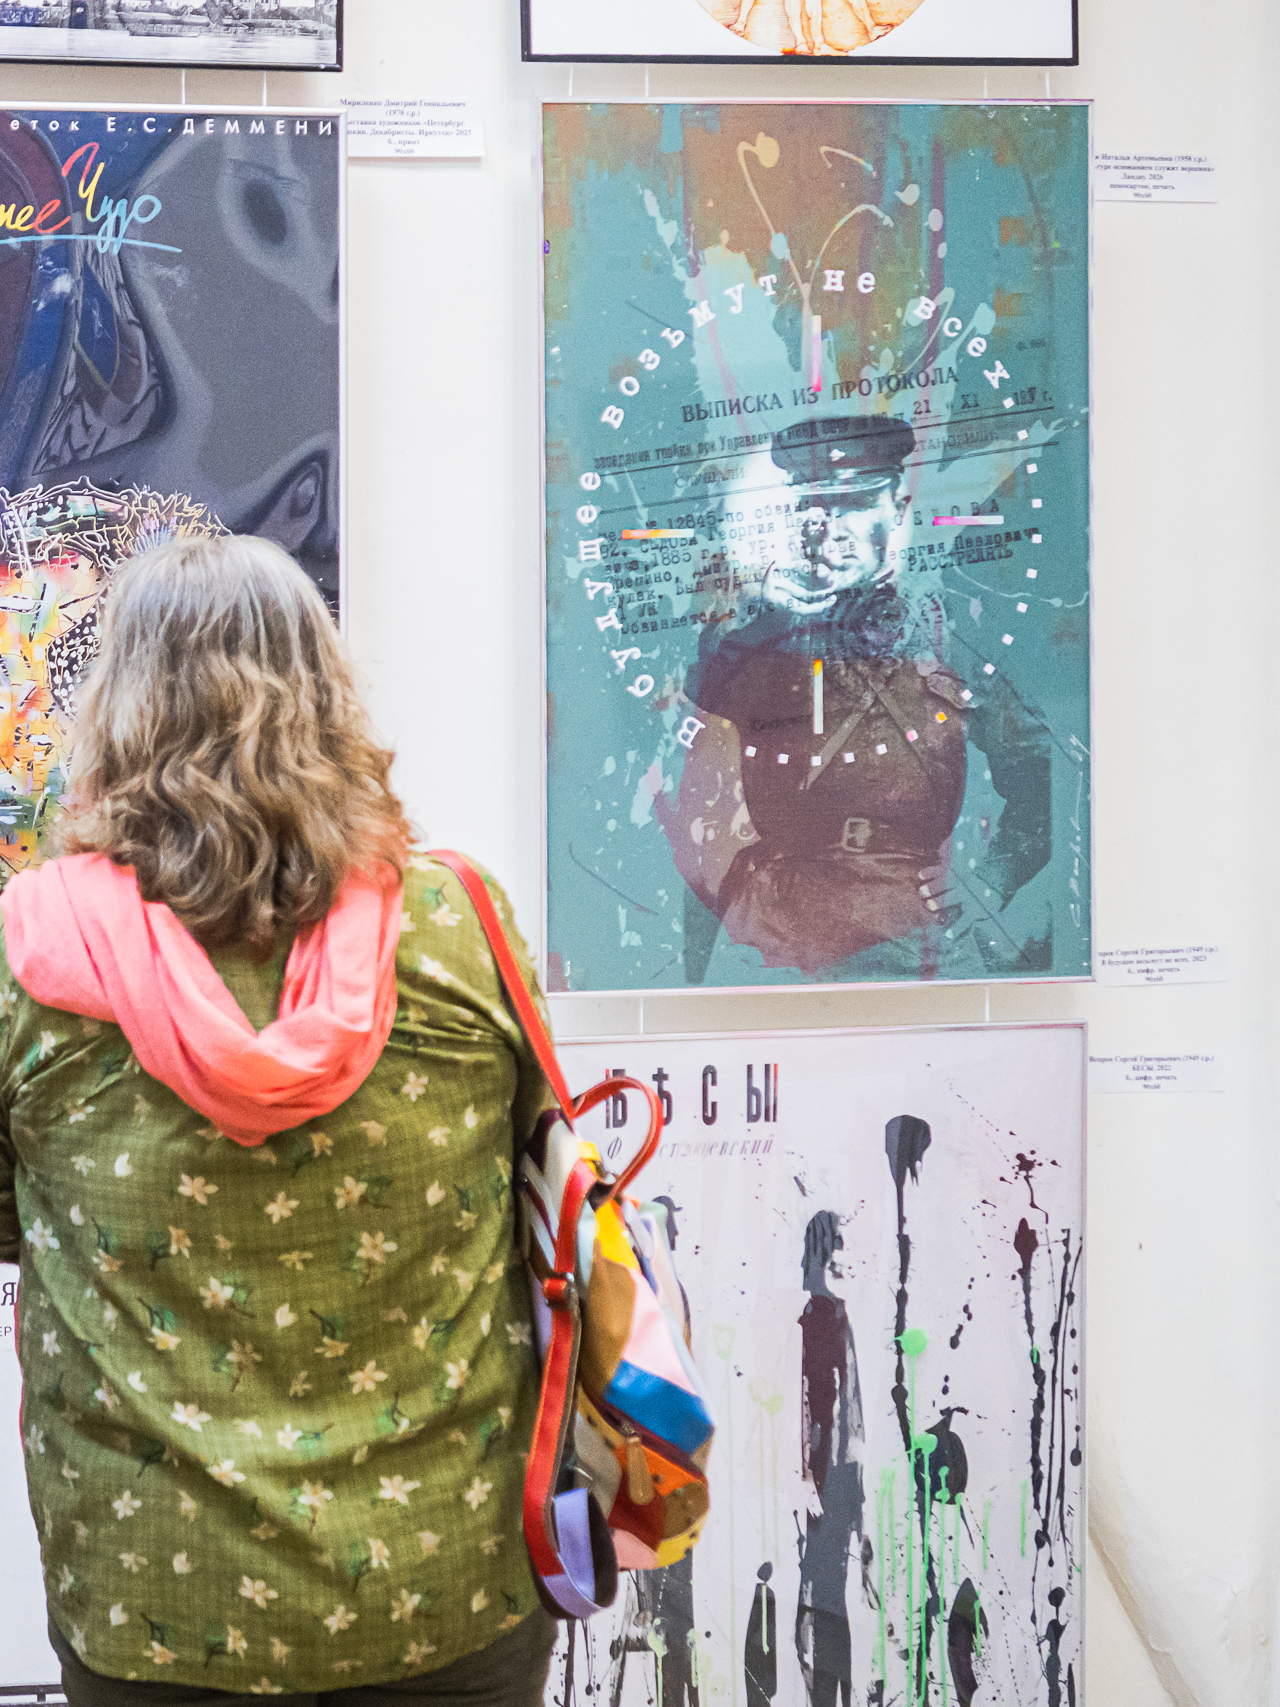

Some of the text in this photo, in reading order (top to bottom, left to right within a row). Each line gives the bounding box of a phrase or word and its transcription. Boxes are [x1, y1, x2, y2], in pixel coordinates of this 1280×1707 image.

[61, 142, 162, 255] Чудо
[600, 273, 778, 430] возьмут
[822, 269, 876, 293] не
[912, 295, 1010, 389] всех
[681, 366, 959, 423] ВЫПИСКА ИЗ ПРОТОКОЛА
